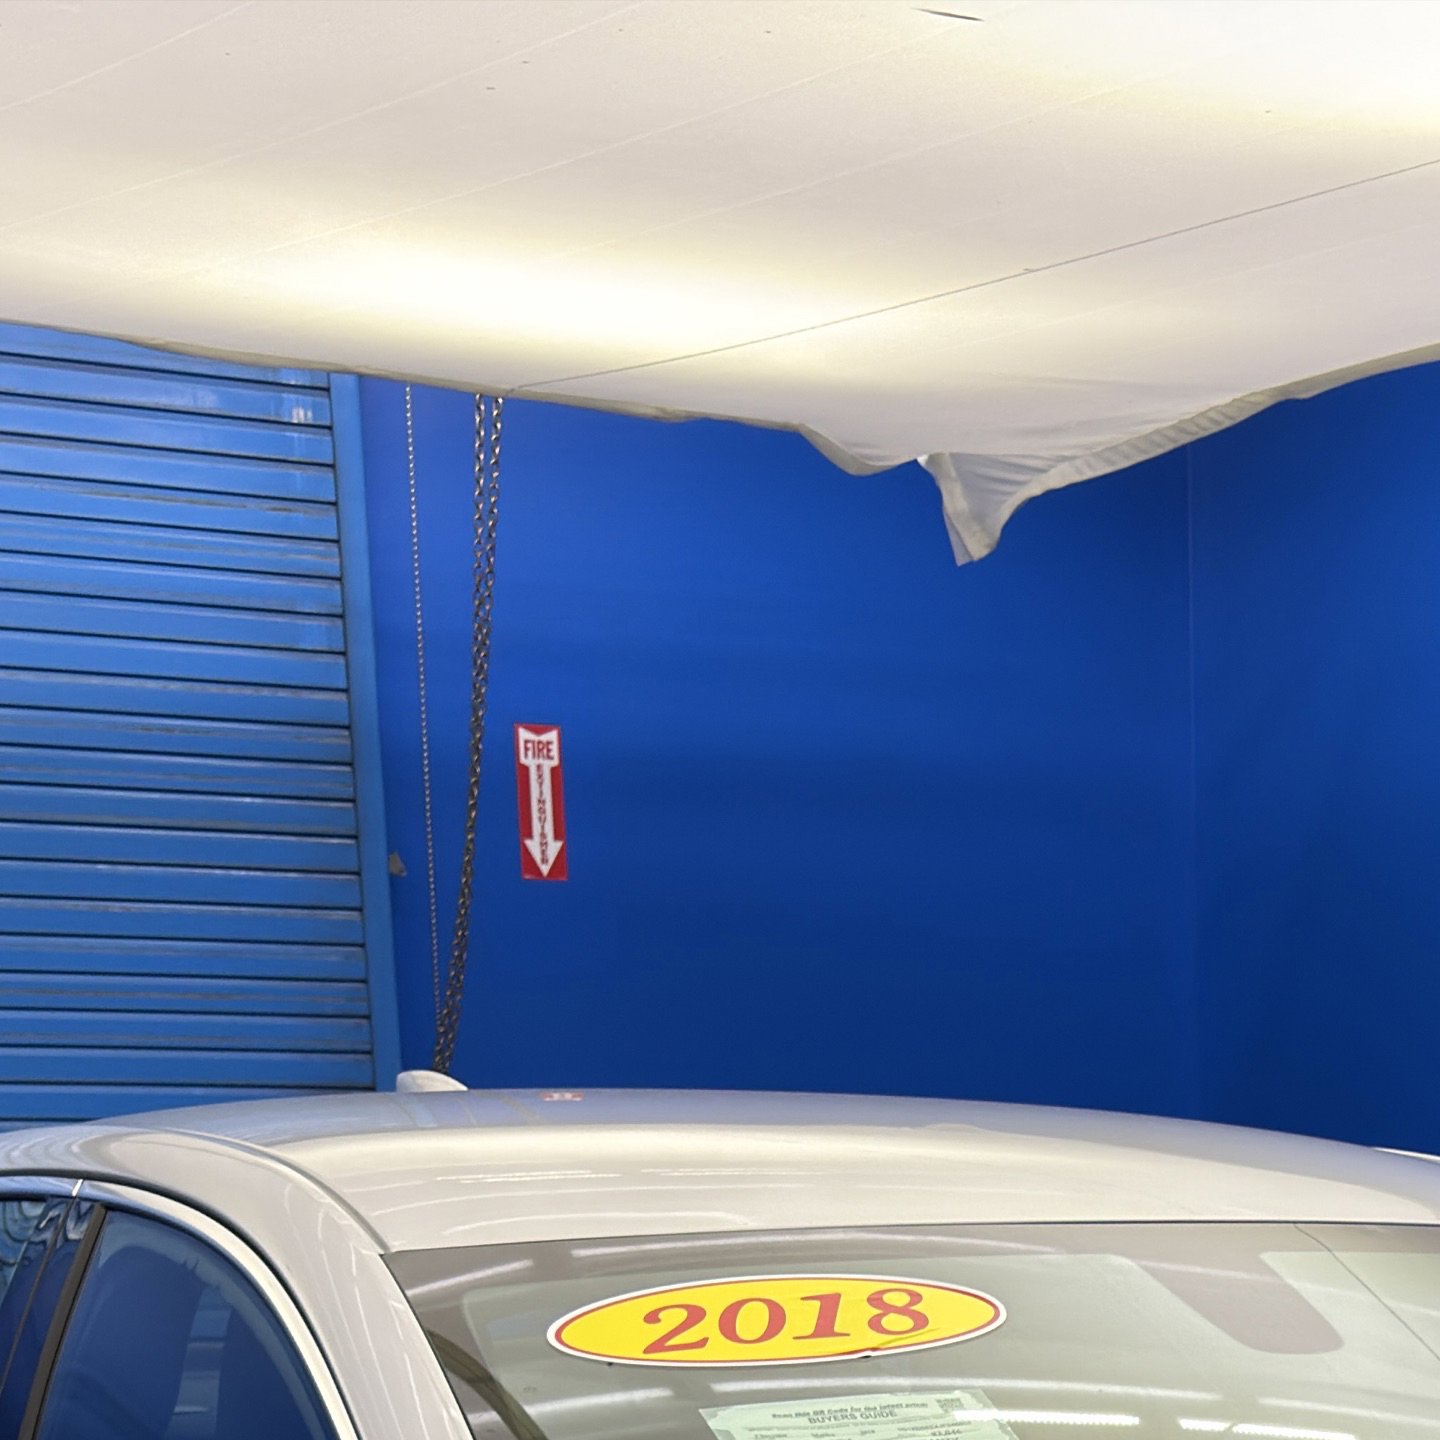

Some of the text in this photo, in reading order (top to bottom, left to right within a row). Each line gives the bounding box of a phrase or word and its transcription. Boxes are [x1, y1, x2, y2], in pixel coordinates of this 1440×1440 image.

[523, 739, 555, 761] FIRE
[536, 763, 549, 866] EXTINGUISHER
[642, 1288, 930, 1355] 2018
[808, 1408, 898, 1425] BUYERS GUIDE
